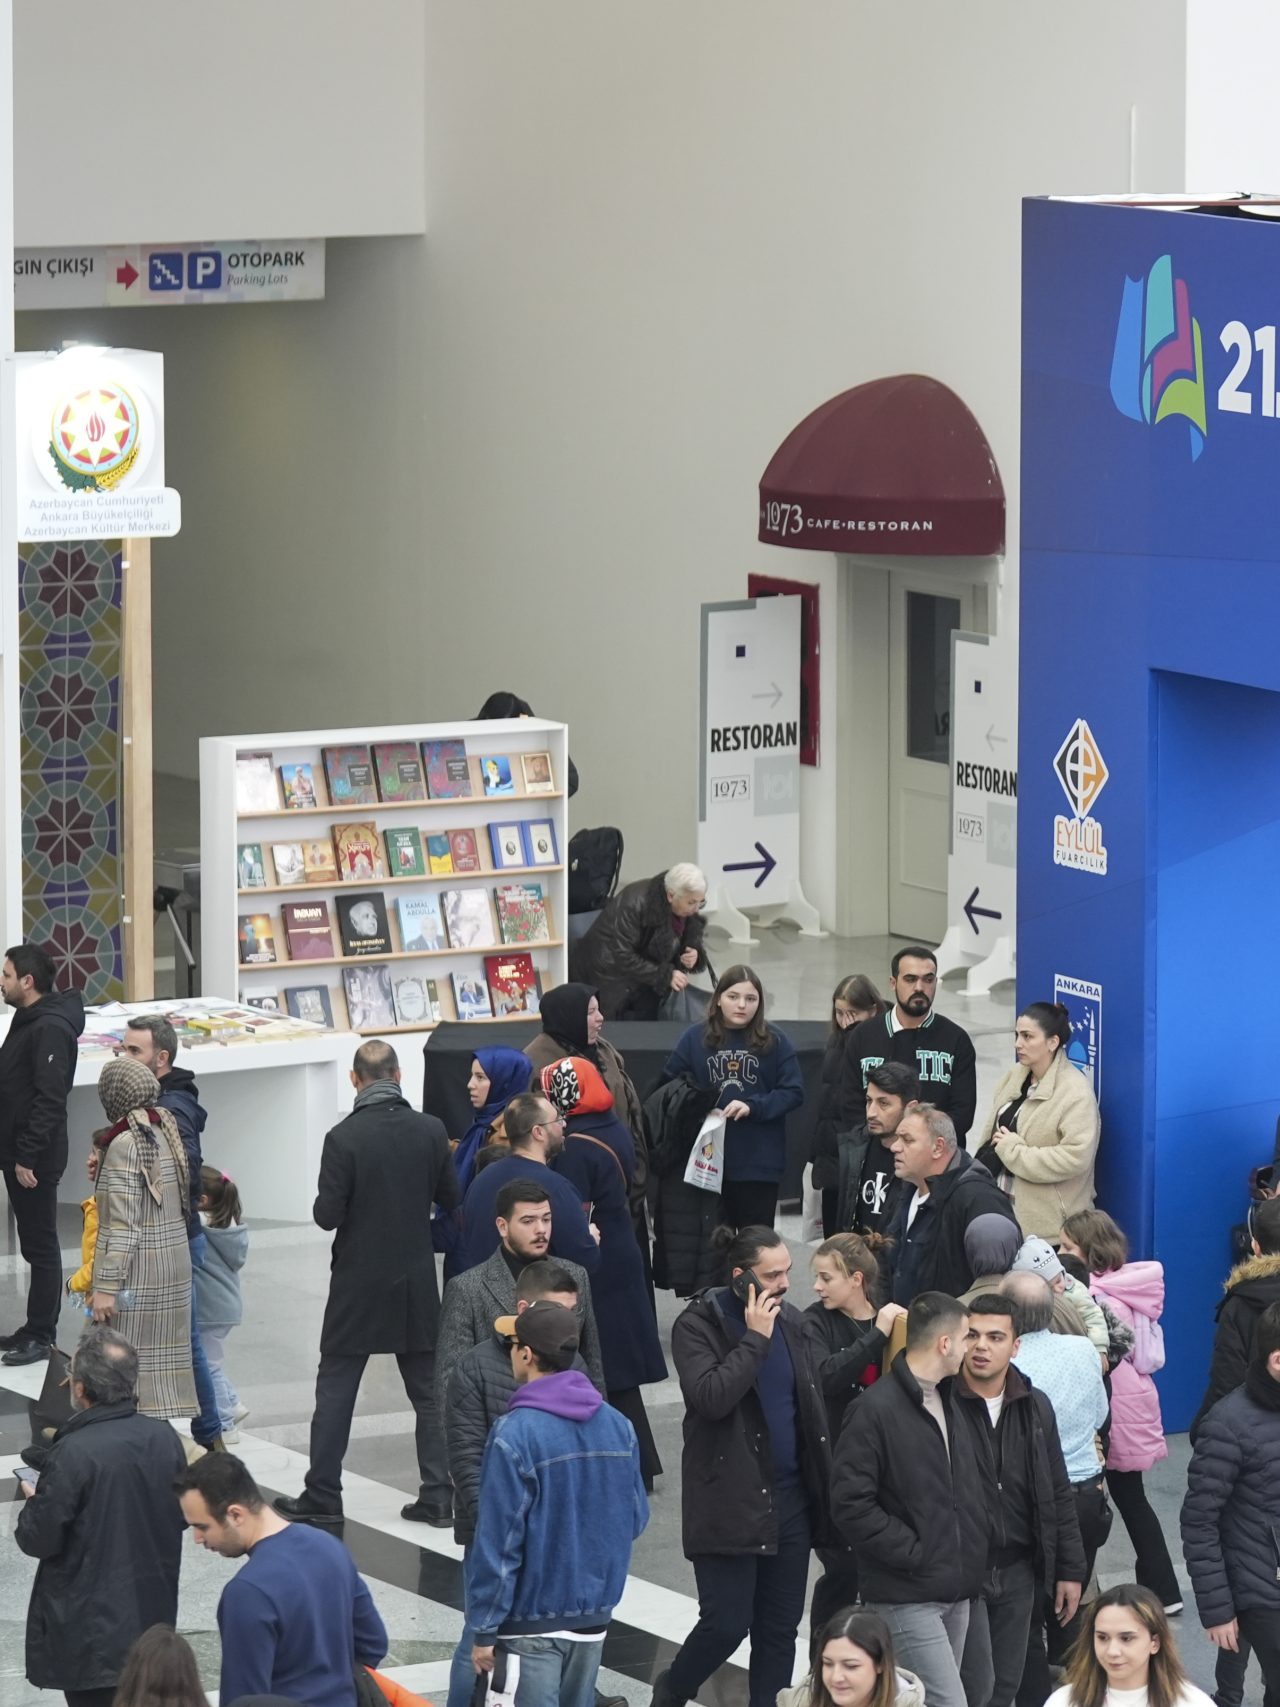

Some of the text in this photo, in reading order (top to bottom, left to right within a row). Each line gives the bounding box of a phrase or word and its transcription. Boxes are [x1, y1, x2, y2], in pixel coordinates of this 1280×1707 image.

[46, 257, 94, 278] ÇIKIŞI
[227, 251, 305, 268] OTOPARK
[227, 273, 288, 286] Parking Lots
[29, 494, 164, 510] Azerbaycan Cumhuriyeti
[40, 510, 79, 522] Ankara
[24, 520, 171, 537] Azerbaycan Kültür Merkezi
[711, 721, 797, 753] RESTORAN
[956, 761, 1017, 797] RESTORAN
[1056, 820, 1105, 856] EYLÜL
[1056, 850, 1105, 869] FUARCILIK
[1056, 978, 1100, 998] ANKARA
[915, 1050, 954, 1084] TIC
